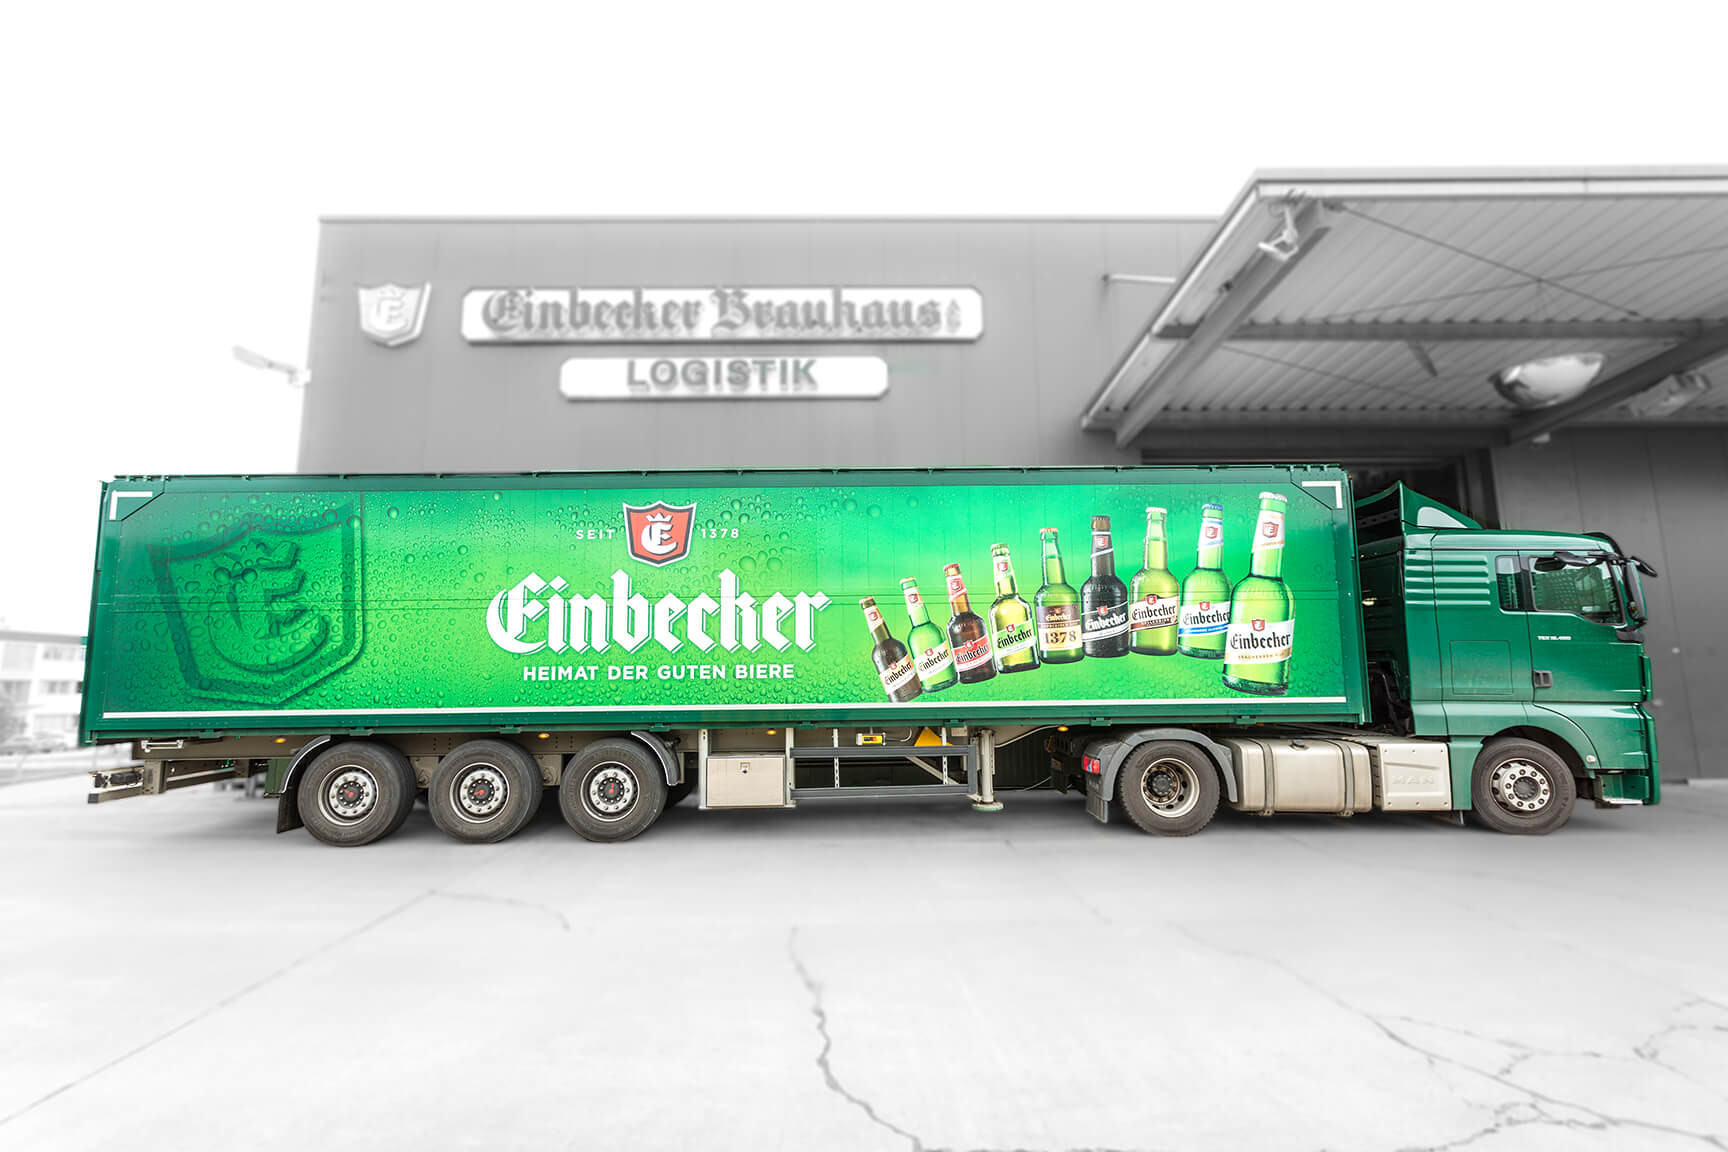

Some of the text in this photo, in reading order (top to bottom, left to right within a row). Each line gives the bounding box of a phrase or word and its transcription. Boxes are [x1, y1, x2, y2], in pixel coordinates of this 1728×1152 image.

[482, 287, 702, 332] Einbecker
[710, 286, 942, 330] Brauhaus
[626, 358, 818, 388] LOGISTIK
[575, 528, 739, 540] SEIT 1378
[485, 568, 833, 656] Einbecker
[1132, 604, 1176, 621] Einbecker
[1045, 630, 1077, 644] 1378
[1230, 632, 1291, 649] Einbecker
[523, 664, 795, 681] HEIMAT DER GUTEN BIERE
